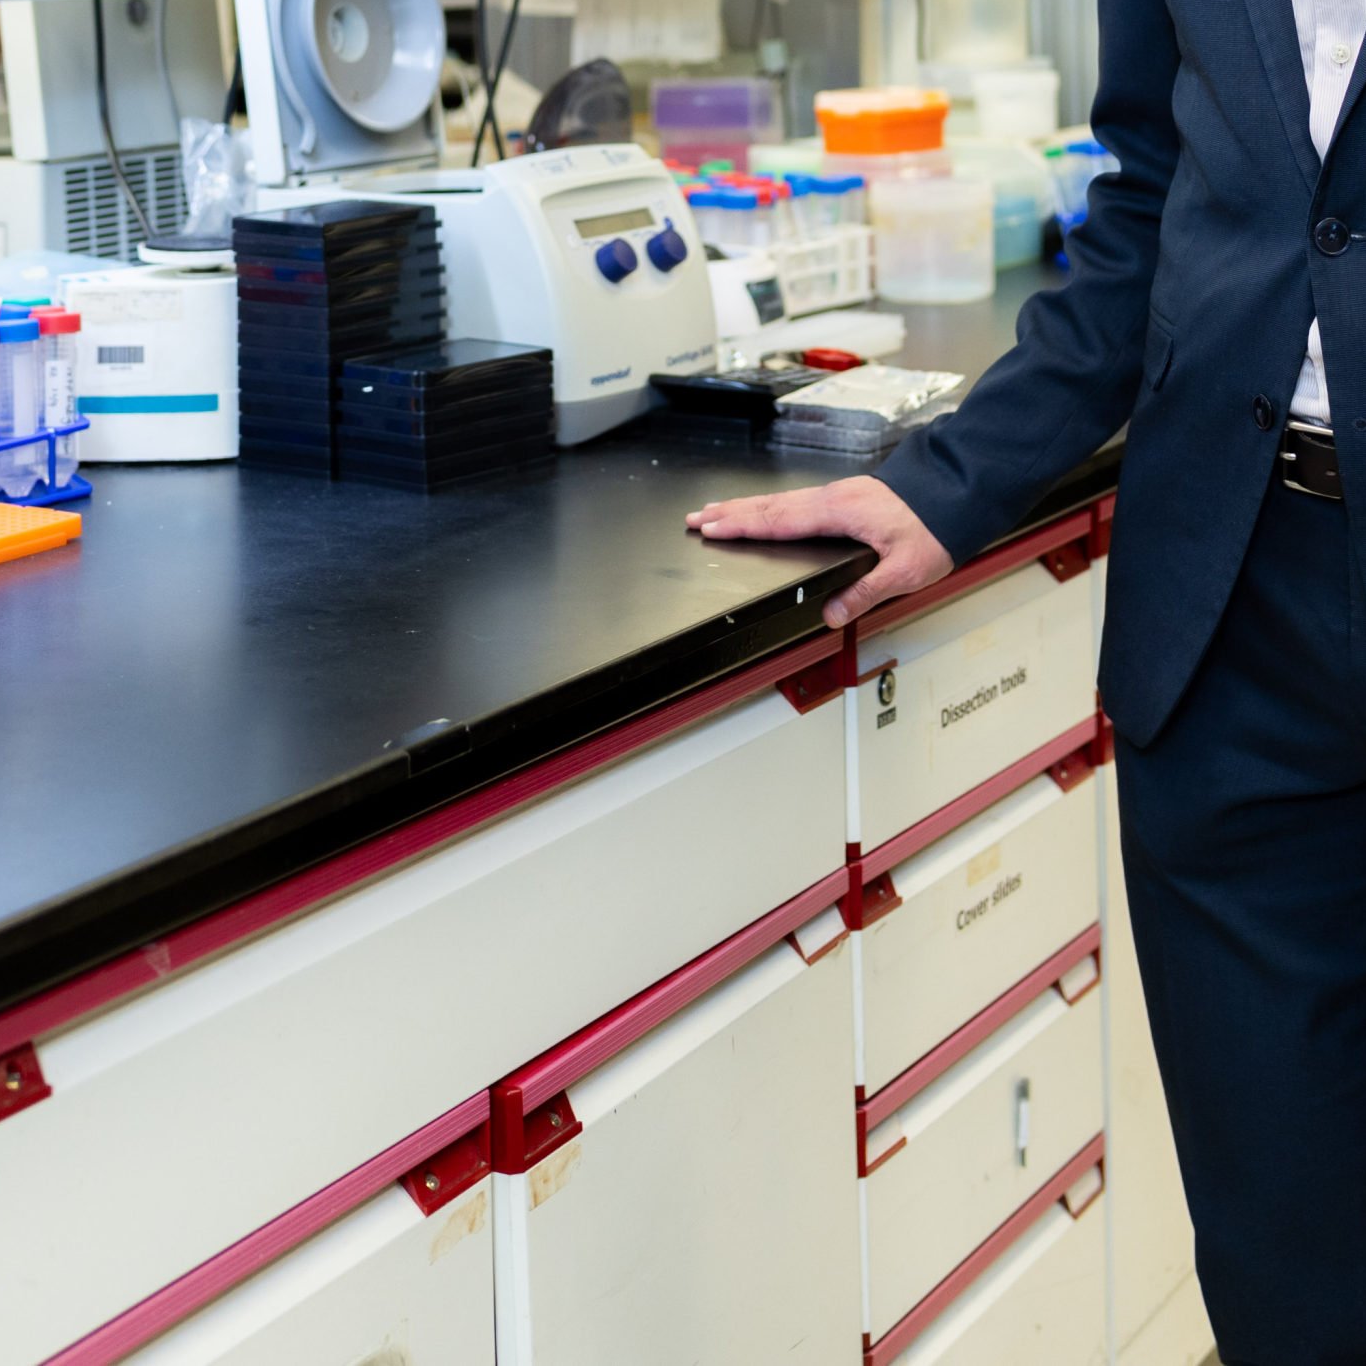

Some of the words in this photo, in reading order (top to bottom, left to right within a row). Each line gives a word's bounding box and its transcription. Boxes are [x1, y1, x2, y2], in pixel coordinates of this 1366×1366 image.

[940, 683, 998, 729] Dissection
[999, 665, 1027, 695] tools
[955, 895, 989, 931] Cover
[991, 871, 1022, 907] slides
